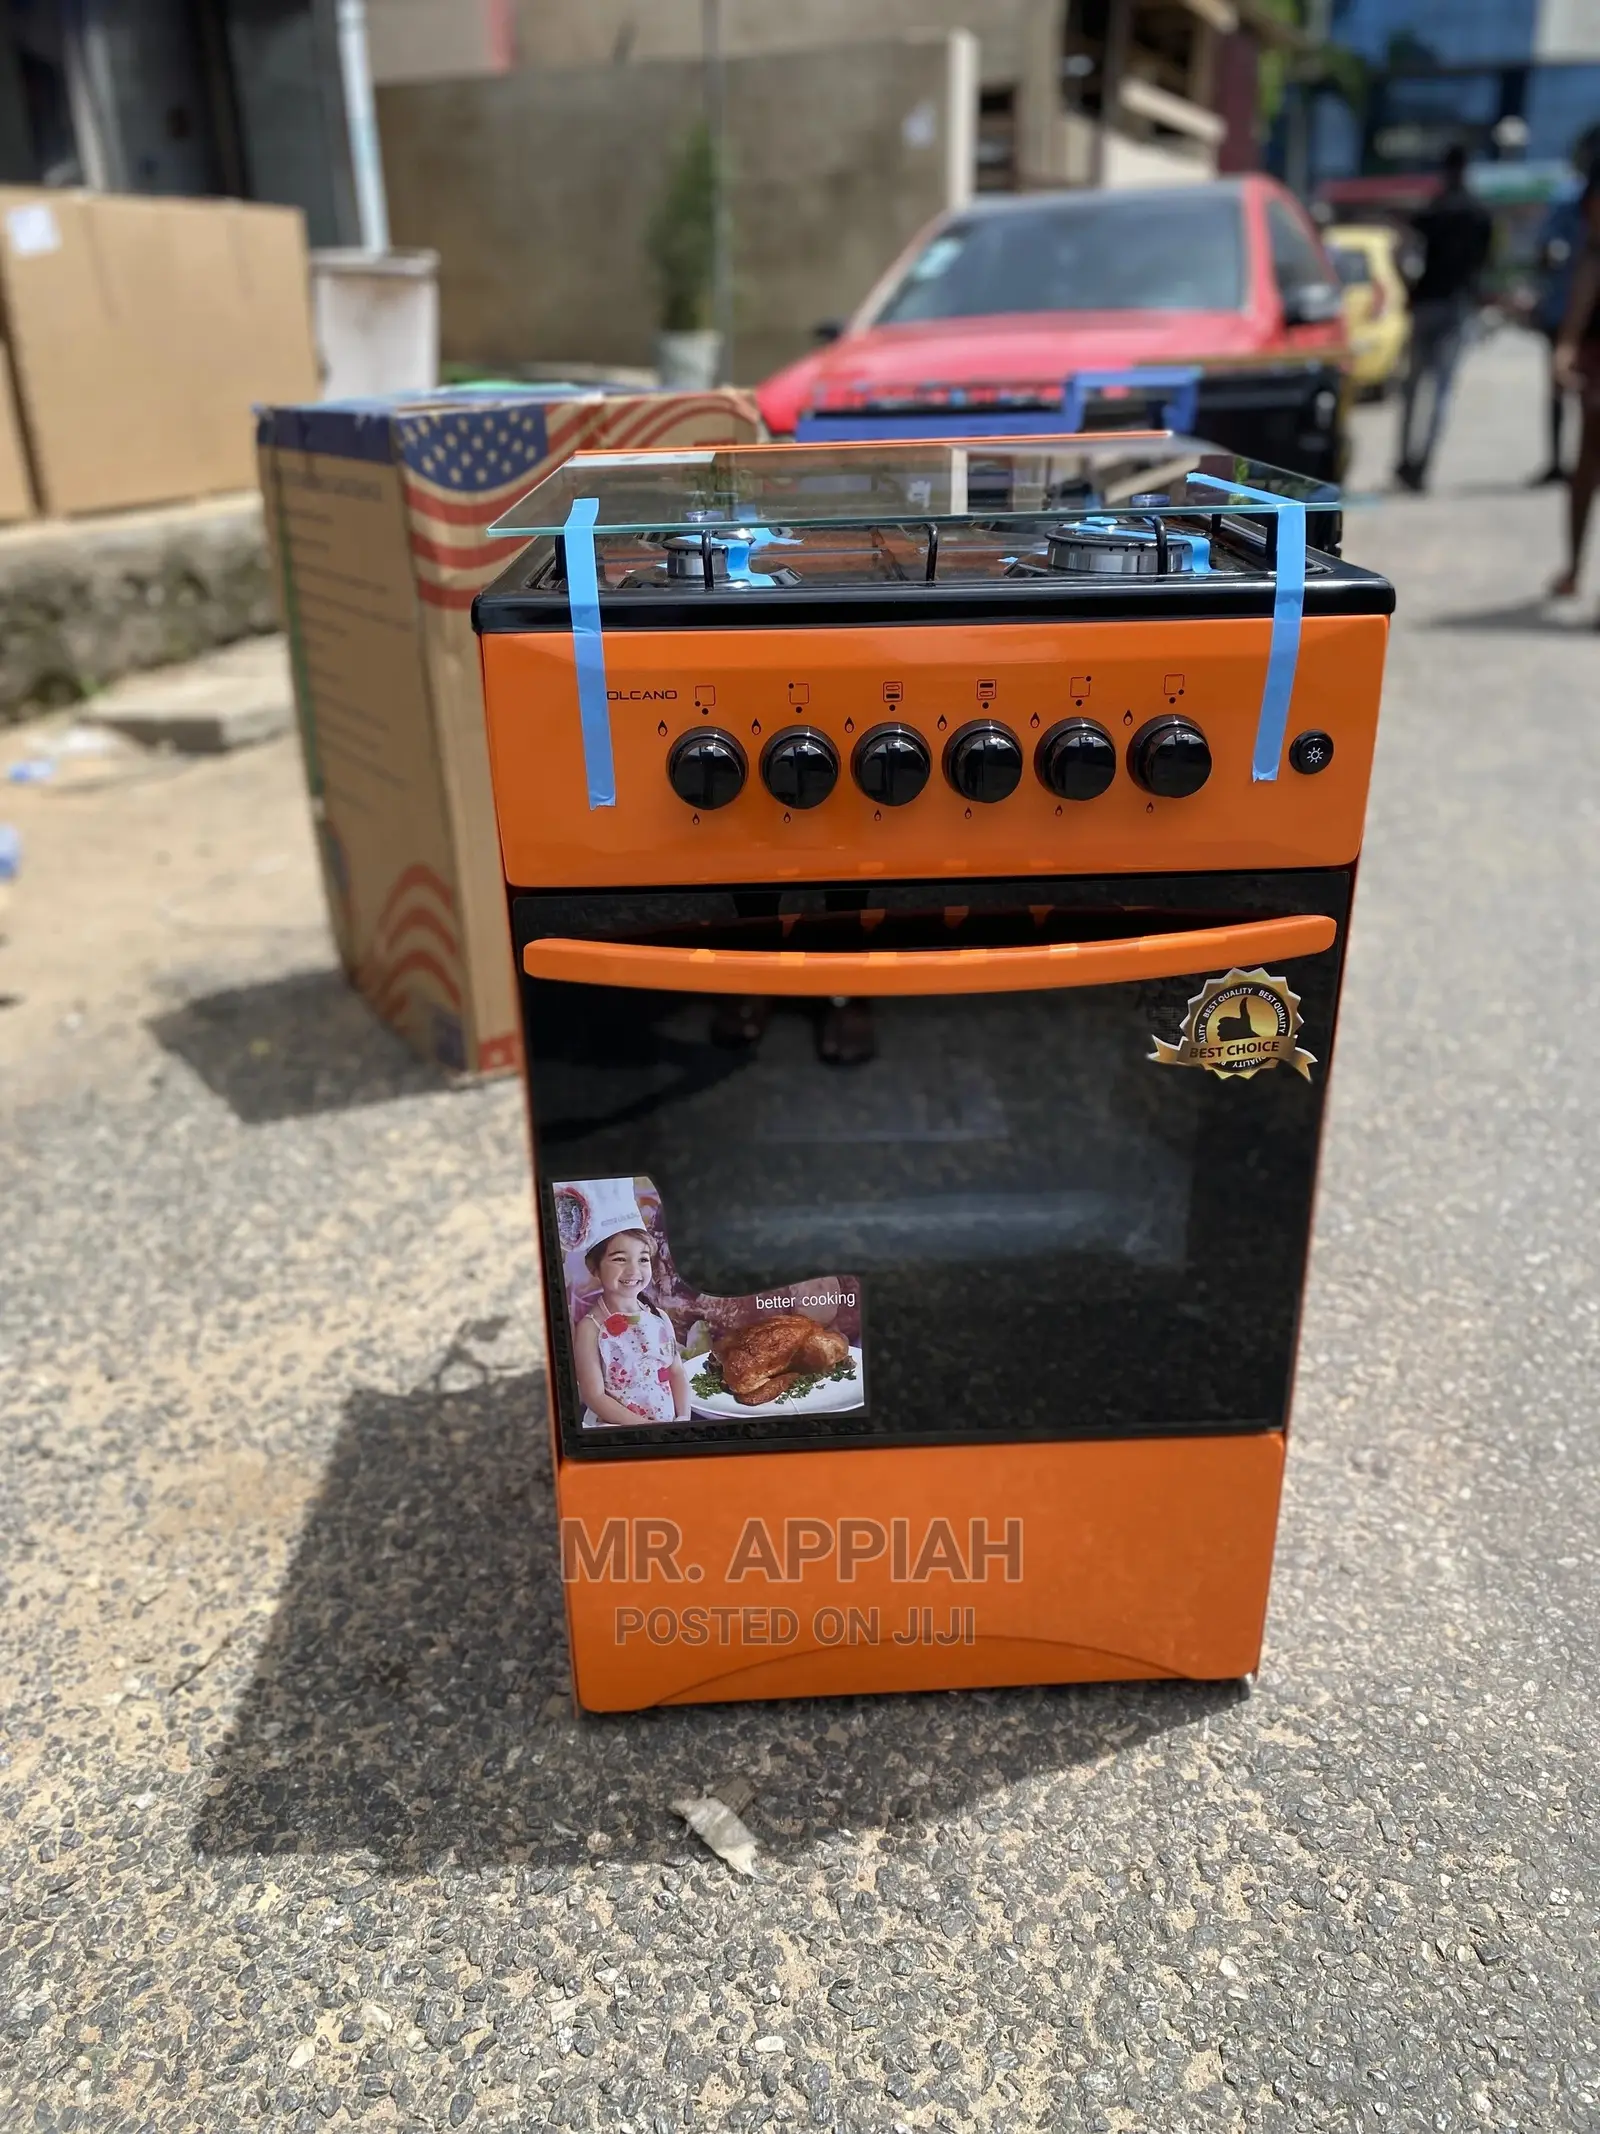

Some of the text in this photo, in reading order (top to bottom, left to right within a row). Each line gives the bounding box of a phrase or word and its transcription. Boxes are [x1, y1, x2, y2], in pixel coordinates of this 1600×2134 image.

[607, 690, 678, 701] OLCANO
[1202, 987, 1253, 1018] BEST QUALITY
[1258, 989, 1287, 1034] BEST QUALITY
[1198, 1023, 1208, 1044] ALITY
[1189, 1041, 1280, 1059] BEST CHOICE
[755, 1291, 856, 1310] better cooking
